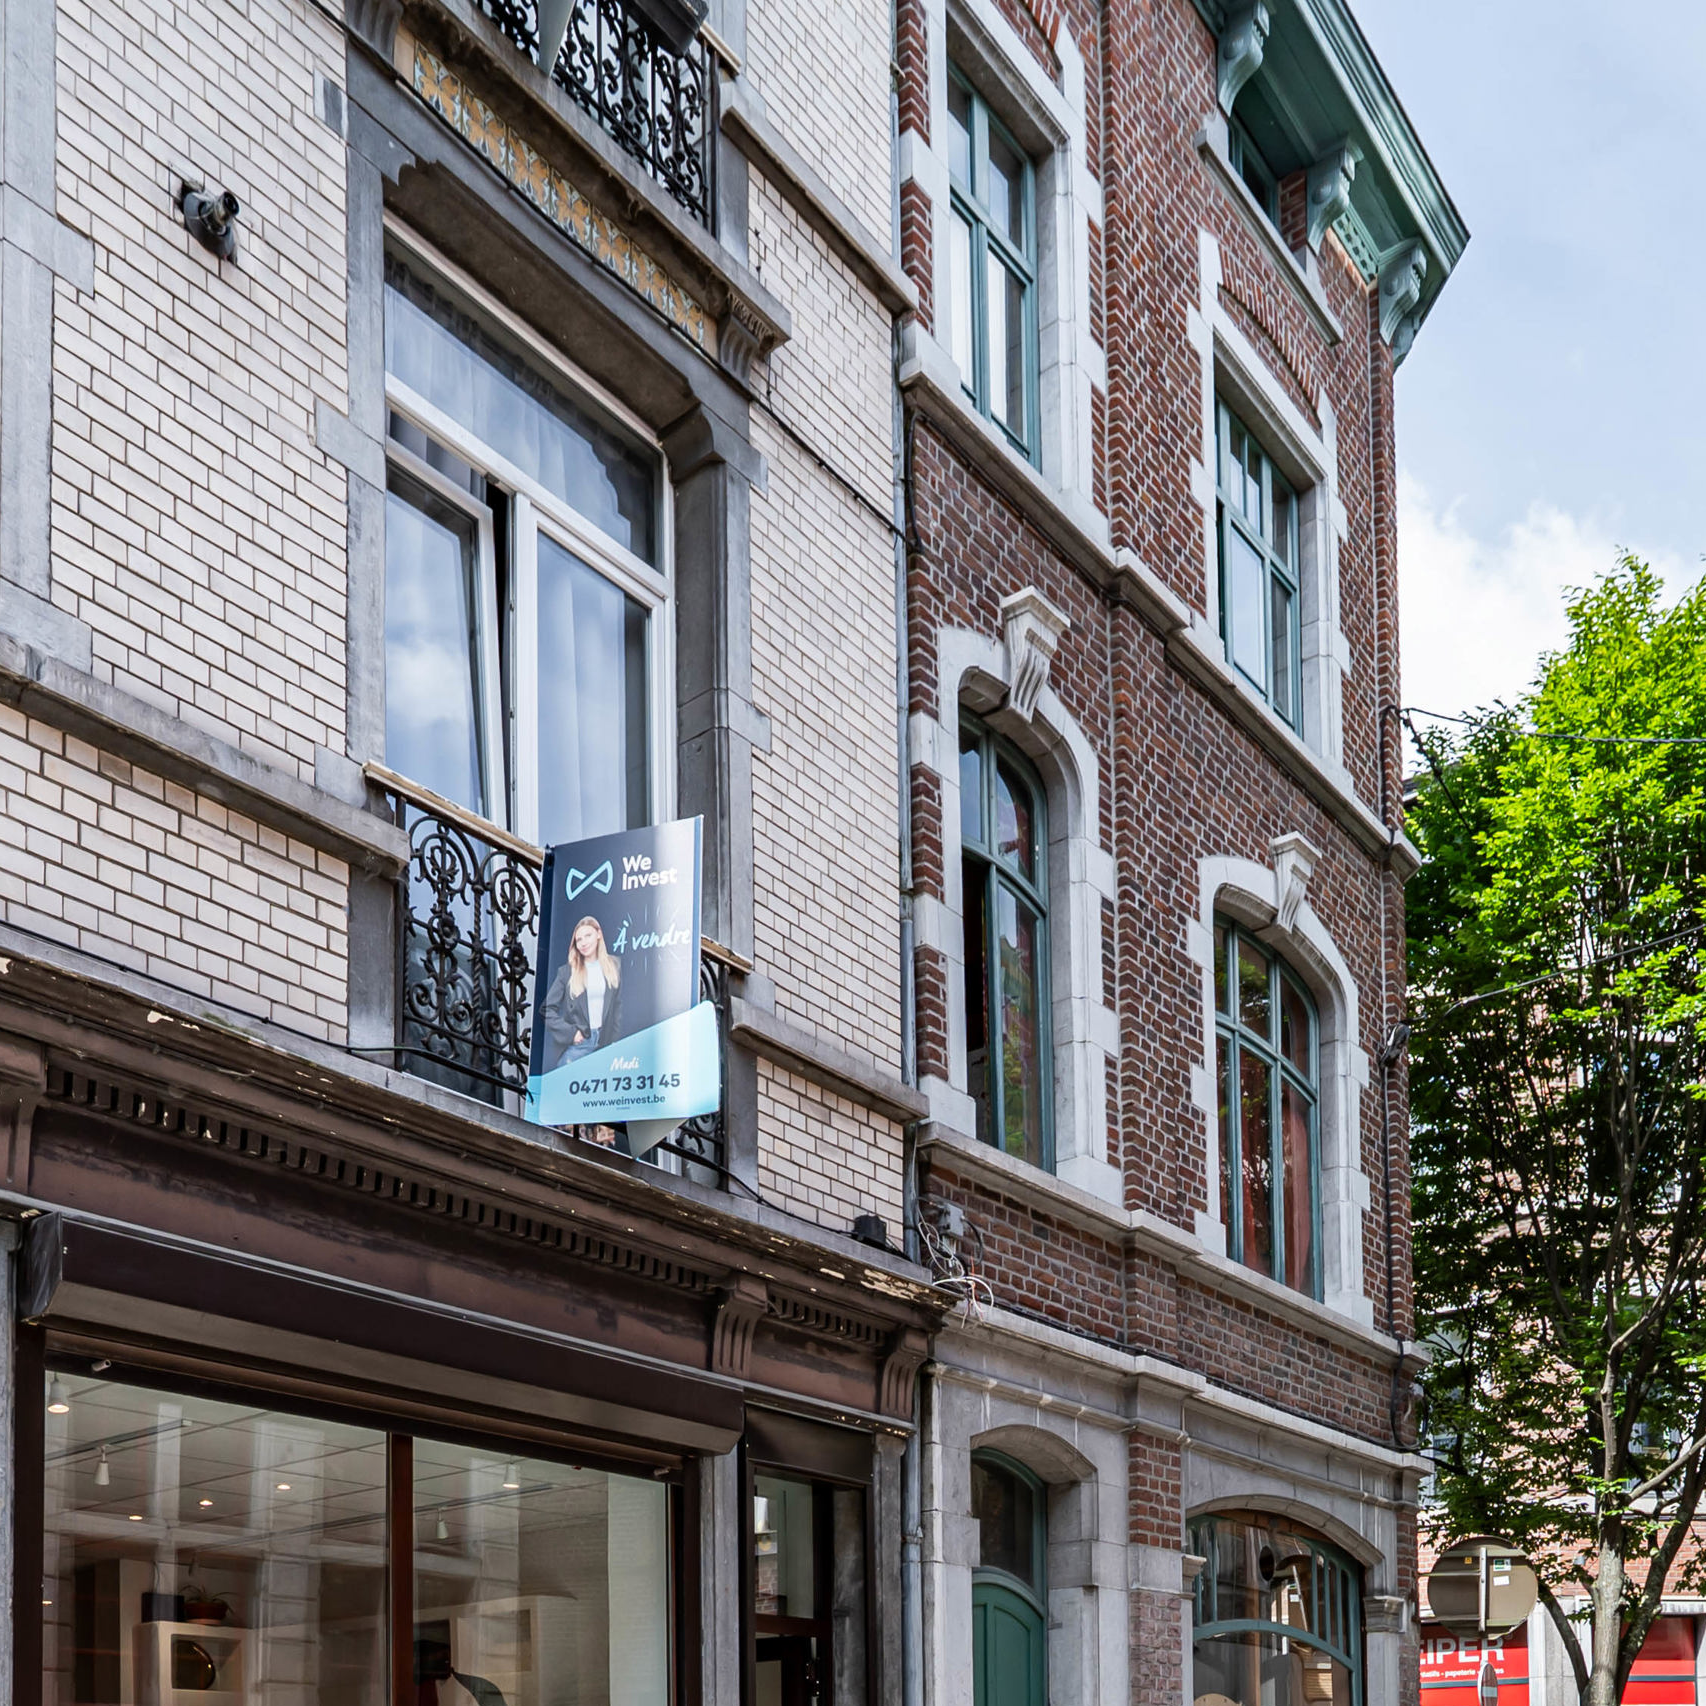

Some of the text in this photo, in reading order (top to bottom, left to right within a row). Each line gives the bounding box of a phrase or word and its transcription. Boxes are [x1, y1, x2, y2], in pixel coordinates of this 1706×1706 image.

[622, 854, 652, 874] We
[632, 922, 691, 951] vendre
[569, 1073, 681, 1095] 0471 73 31 45
[582, 1094, 666, 1108] www.weinvest.be
